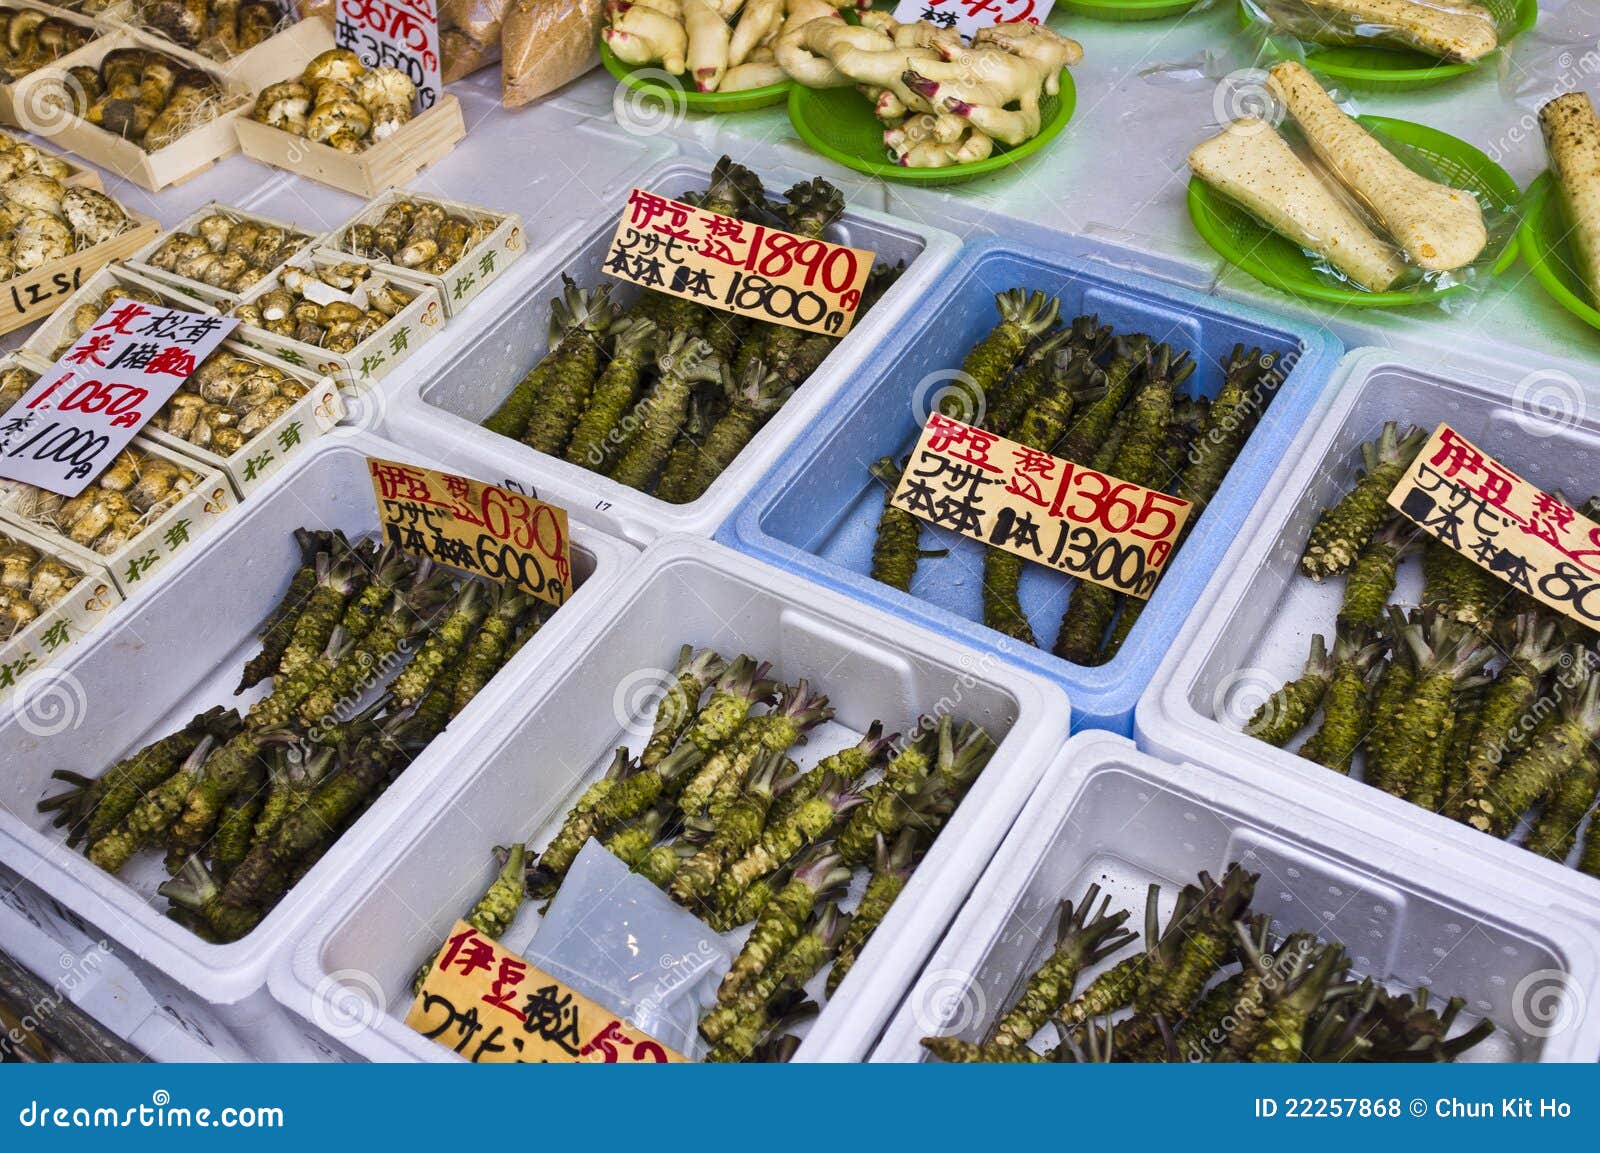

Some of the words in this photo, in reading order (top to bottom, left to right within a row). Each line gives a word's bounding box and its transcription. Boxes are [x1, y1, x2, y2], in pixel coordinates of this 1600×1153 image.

[628, 189, 699, 244] 伊豆
[454, 249, 498, 300] 松茸
[360, 326, 412, 380] 松茸
[243, 421, 304, 482] 松茸
[925, 413, 1003, 474] 伊豆
[124, 518, 192, 584] 松茸
[439, 929, 527, 1022] 伊豆
